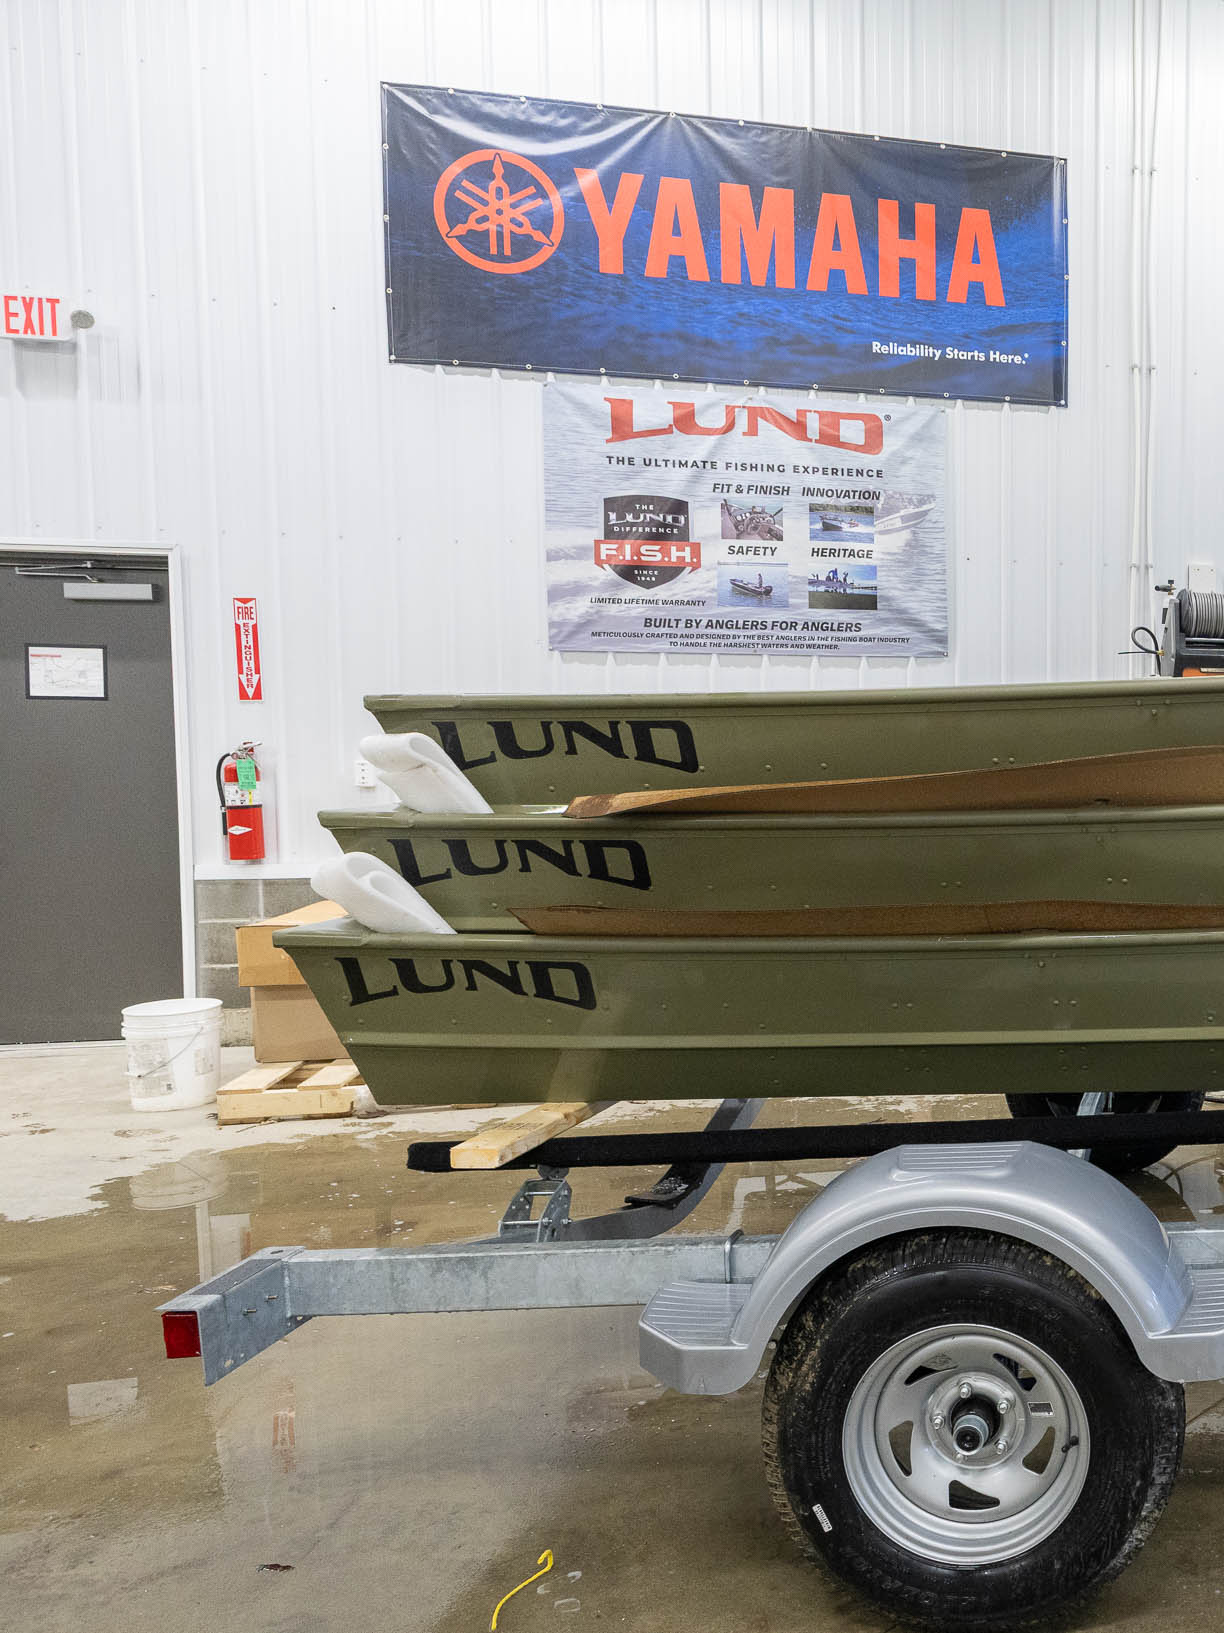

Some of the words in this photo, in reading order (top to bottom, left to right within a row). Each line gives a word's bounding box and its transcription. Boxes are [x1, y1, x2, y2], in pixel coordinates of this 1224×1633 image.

[574, 167, 1006, 307] YAMAHA
[3, 295, 60, 337] EXIT
[872, 341, 941, 361] Reliability
[945, 347, 985, 362] Starts
[606, 455, 635, 466] THE
[643, 458, 718, 470] ULTIMATE
[725, 462, 786, 473] FISHING
[793, 465, 884, 478] EXPERIENCE
[712, 483, 732, 494] FIT
[735, 484, 744, 494] &
[747, 484, 791, 496] FINISH
[802, 487, 881, 501] INNOVATION
[608, 512, 687, 526] LUND
[613, 526, 679, 534] DIFFERENCE
[600, 543, 697, 562] F.I.S.H.
[727, 545, 778, 556] SAFETY
[811, 547, 873, 559] HERITAGE
[590, 597, 623, 605] LIMITED
[624, 598, 660, 606] LIFETIME
[661, 599, 706, 607] WARRANTY
[237, 606, 254, 621] FIRE
[644, 617, 682, 629] BUILT
[684, 618, 702, 629] BY
[704, 619, 768, 631] ANGLERS
[771, 620, 798, 631] FOR
[800, 621, 862, 633] ANGLERS
[243, 622, 254, 689] EXTINGUISHER
[431, 720, 699, 773] LUND
[387, 839, 651, 890] LUND
[334, 957, 597, 1010] LUND
